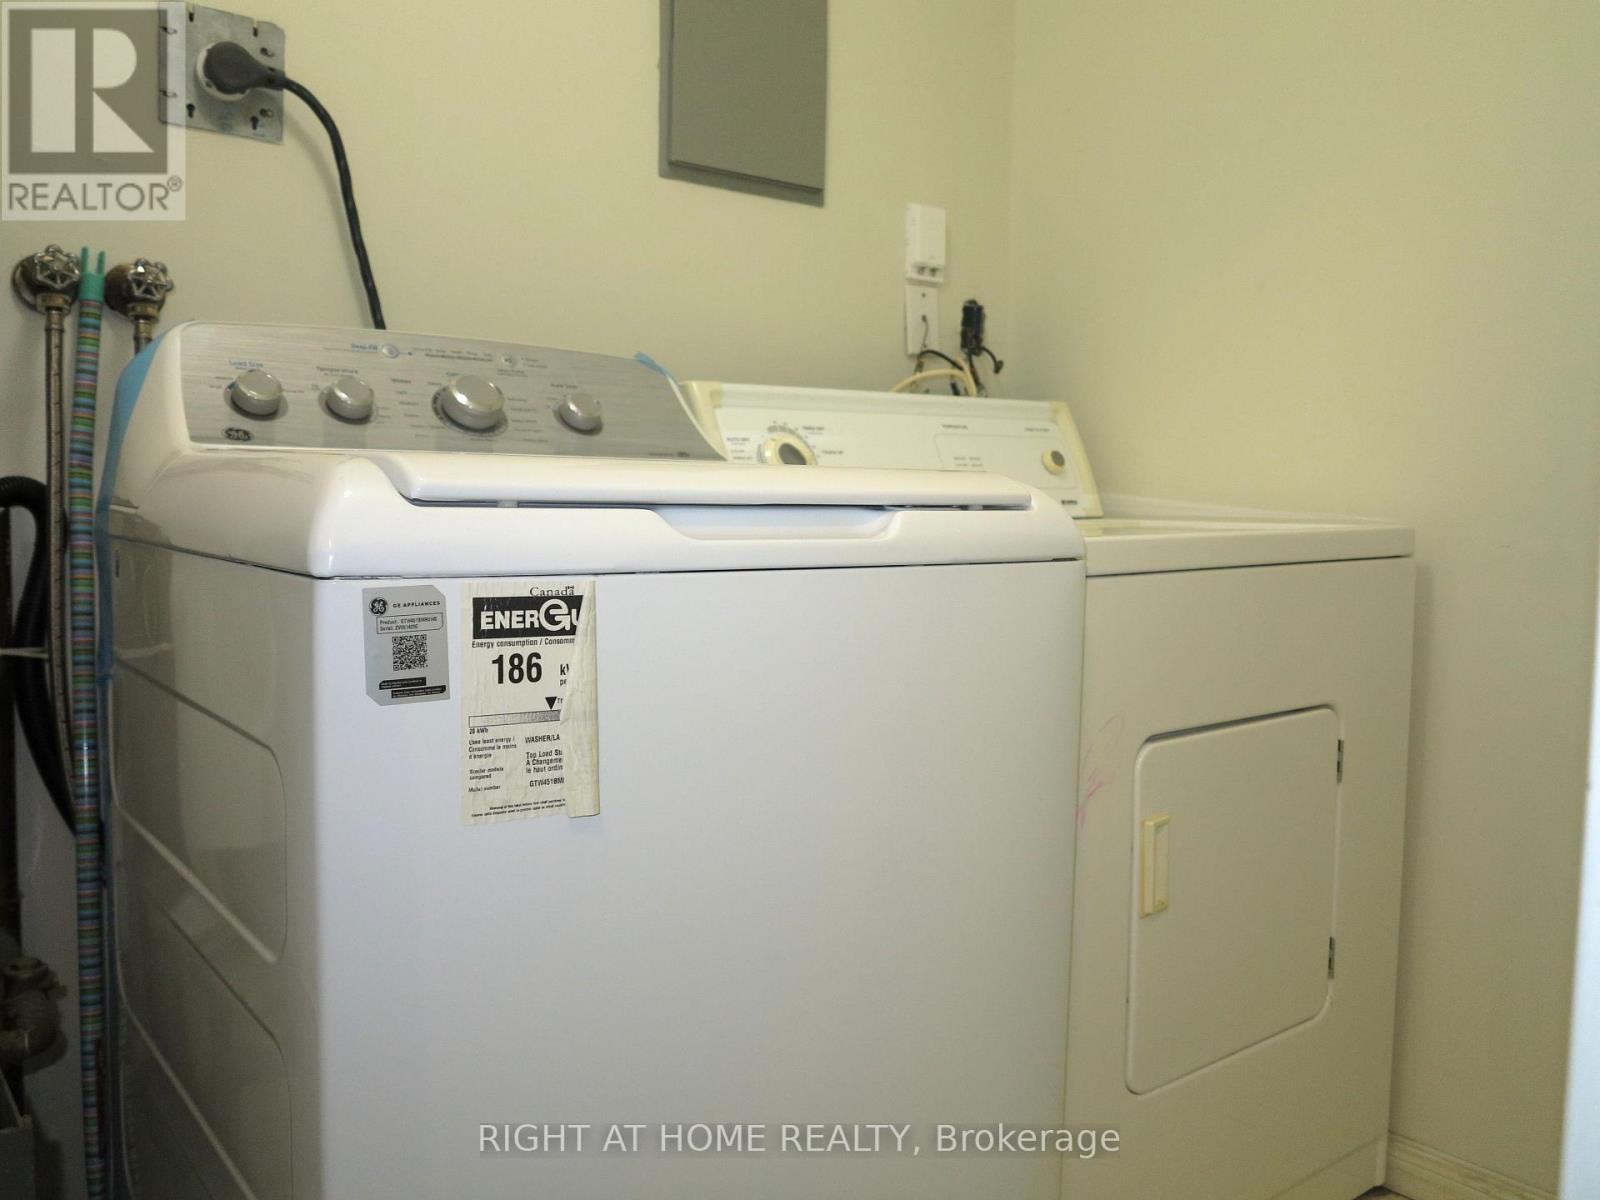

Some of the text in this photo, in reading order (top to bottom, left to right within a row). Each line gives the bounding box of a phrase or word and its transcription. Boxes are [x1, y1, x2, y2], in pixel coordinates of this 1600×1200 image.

[529, 586, 575, 597] Canada
[471, 640, 494, 649] Energy
[496, 638, 538, 648] consumption
[491, 652, 542, 685] 186
[524, 733, 561, 744] WASHER/LA
[526, 751, 537, 759] Top
[538, 750, 552, 758] Load
